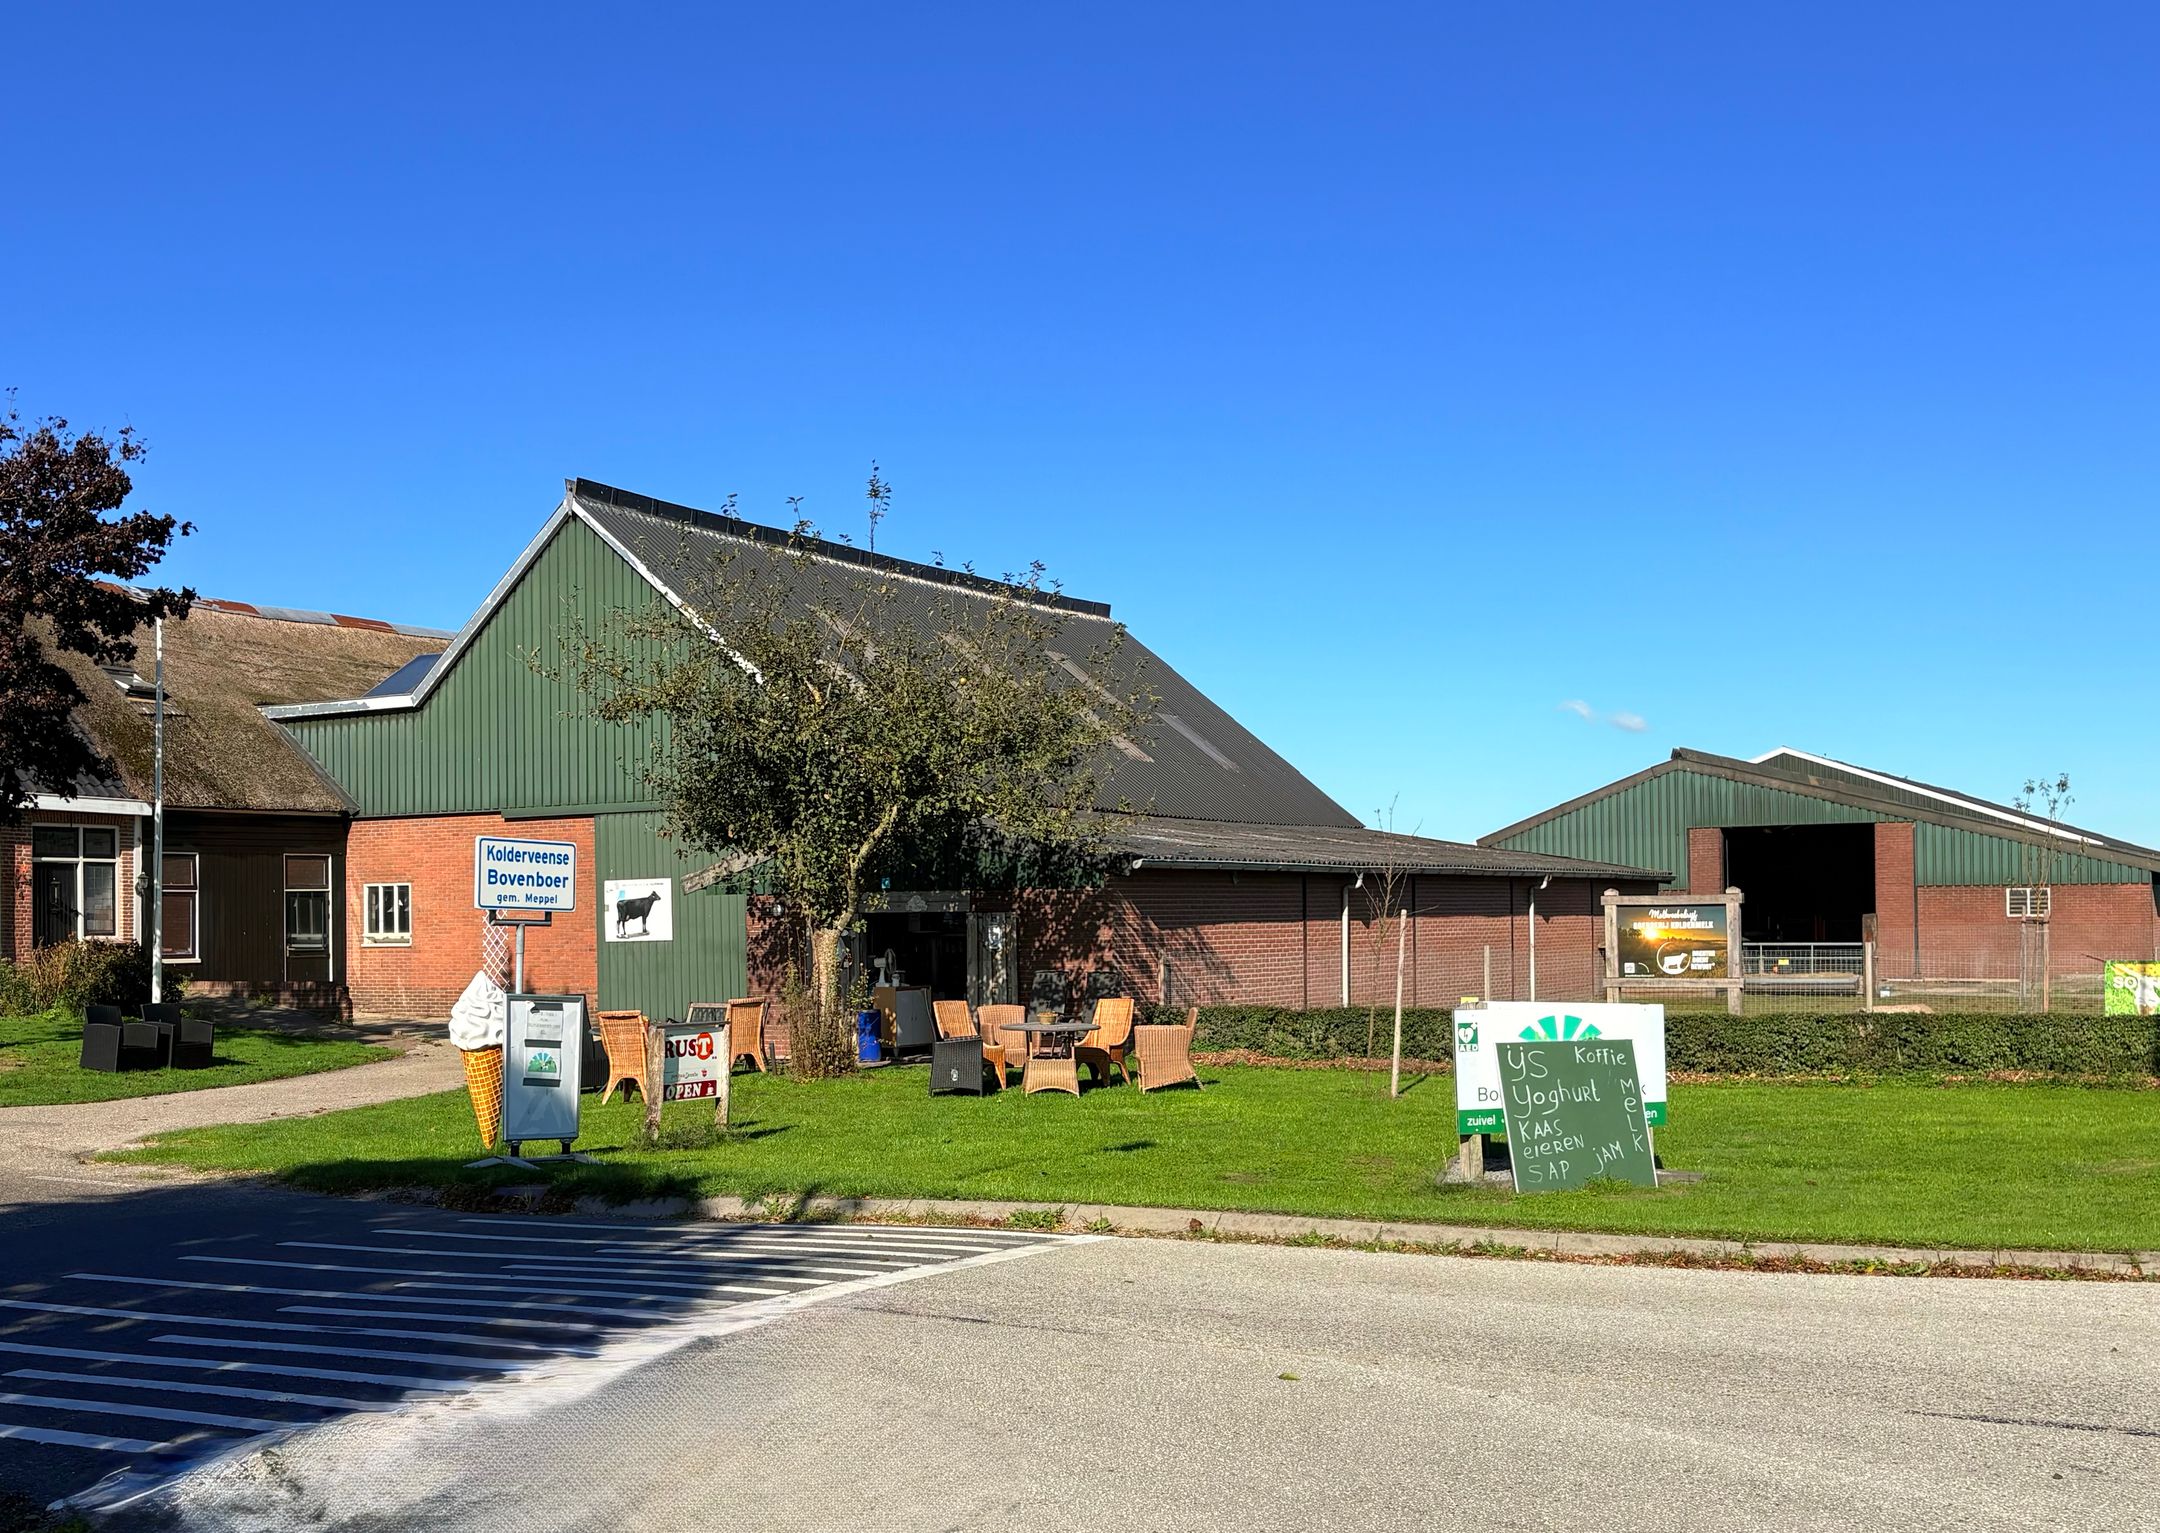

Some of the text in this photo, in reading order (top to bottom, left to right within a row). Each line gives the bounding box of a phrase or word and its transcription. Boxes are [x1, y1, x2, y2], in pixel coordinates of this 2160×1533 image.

[486, 845, 570, 865] Kolderveense
[487, 868, 569, 888] Bovenboer
[496, 893, 558, 905] gem. Meppel
[665, 1082, 703, 1100] OPEN
[1467, 1115, 1496, 1127] zuivel
[1518, 1119, 1563, 1143] KAAS
[1528, 1160, 1570, 1183] SAP
